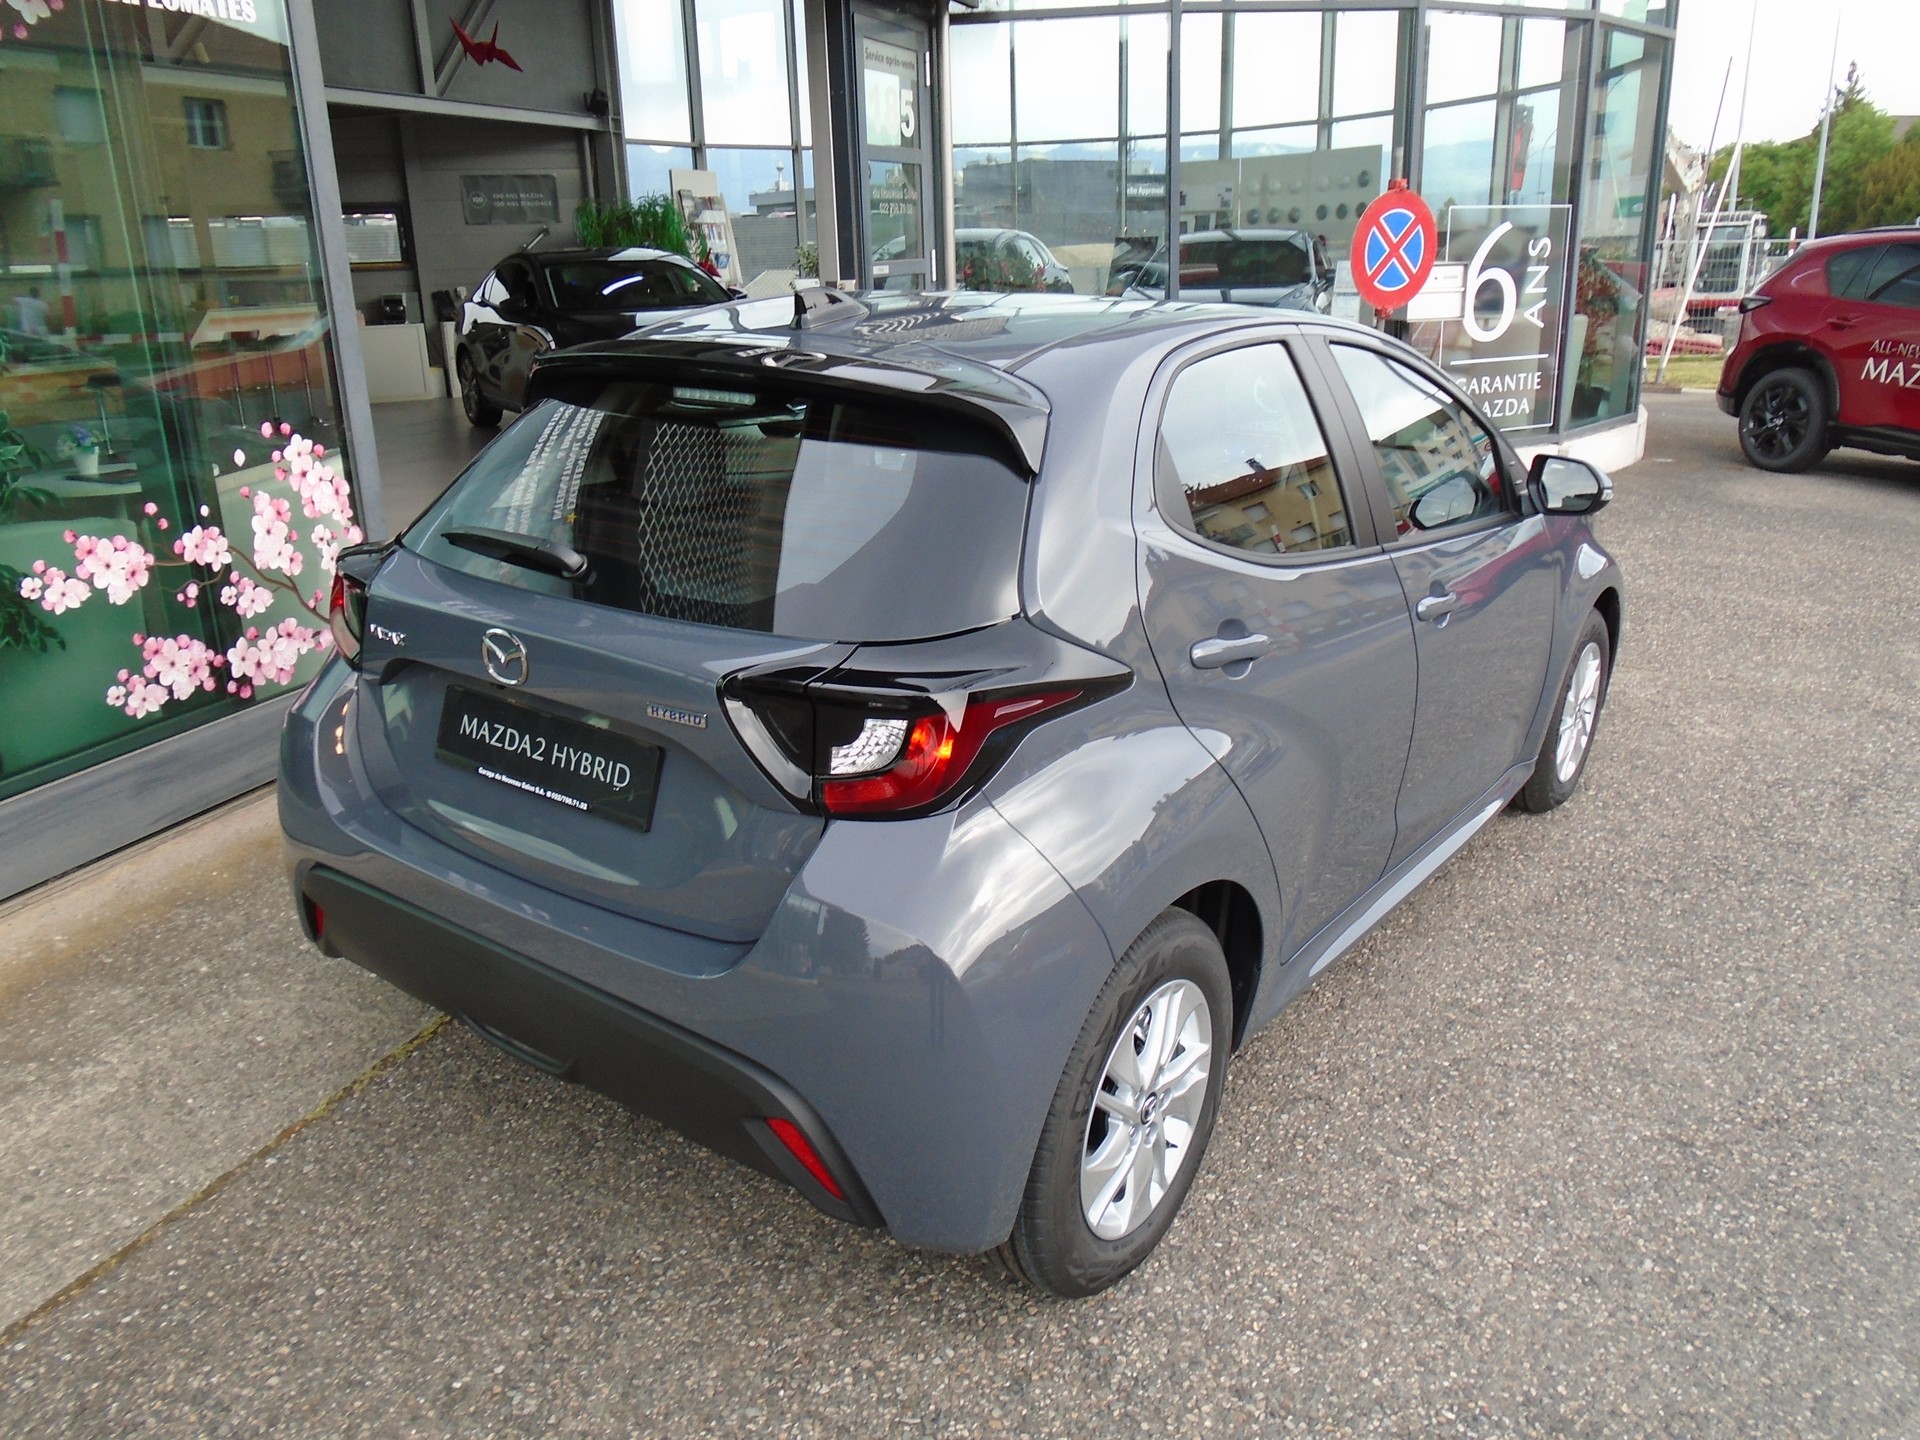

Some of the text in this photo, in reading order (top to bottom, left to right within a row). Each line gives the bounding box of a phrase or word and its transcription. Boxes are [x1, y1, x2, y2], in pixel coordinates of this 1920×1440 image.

[106, 0, 257, 23] MATES
[1463, 221, 1517, 342] 6
[1523, 236, 1552, 329] ANS
[1456, 371, 1542, 396] GARANTIE
[1482, 396, 1530, 418] AZDA
[651, 705, 702, 725] HYBRID
[459, 714, 631, 788] MAZDA2 HYBRID
